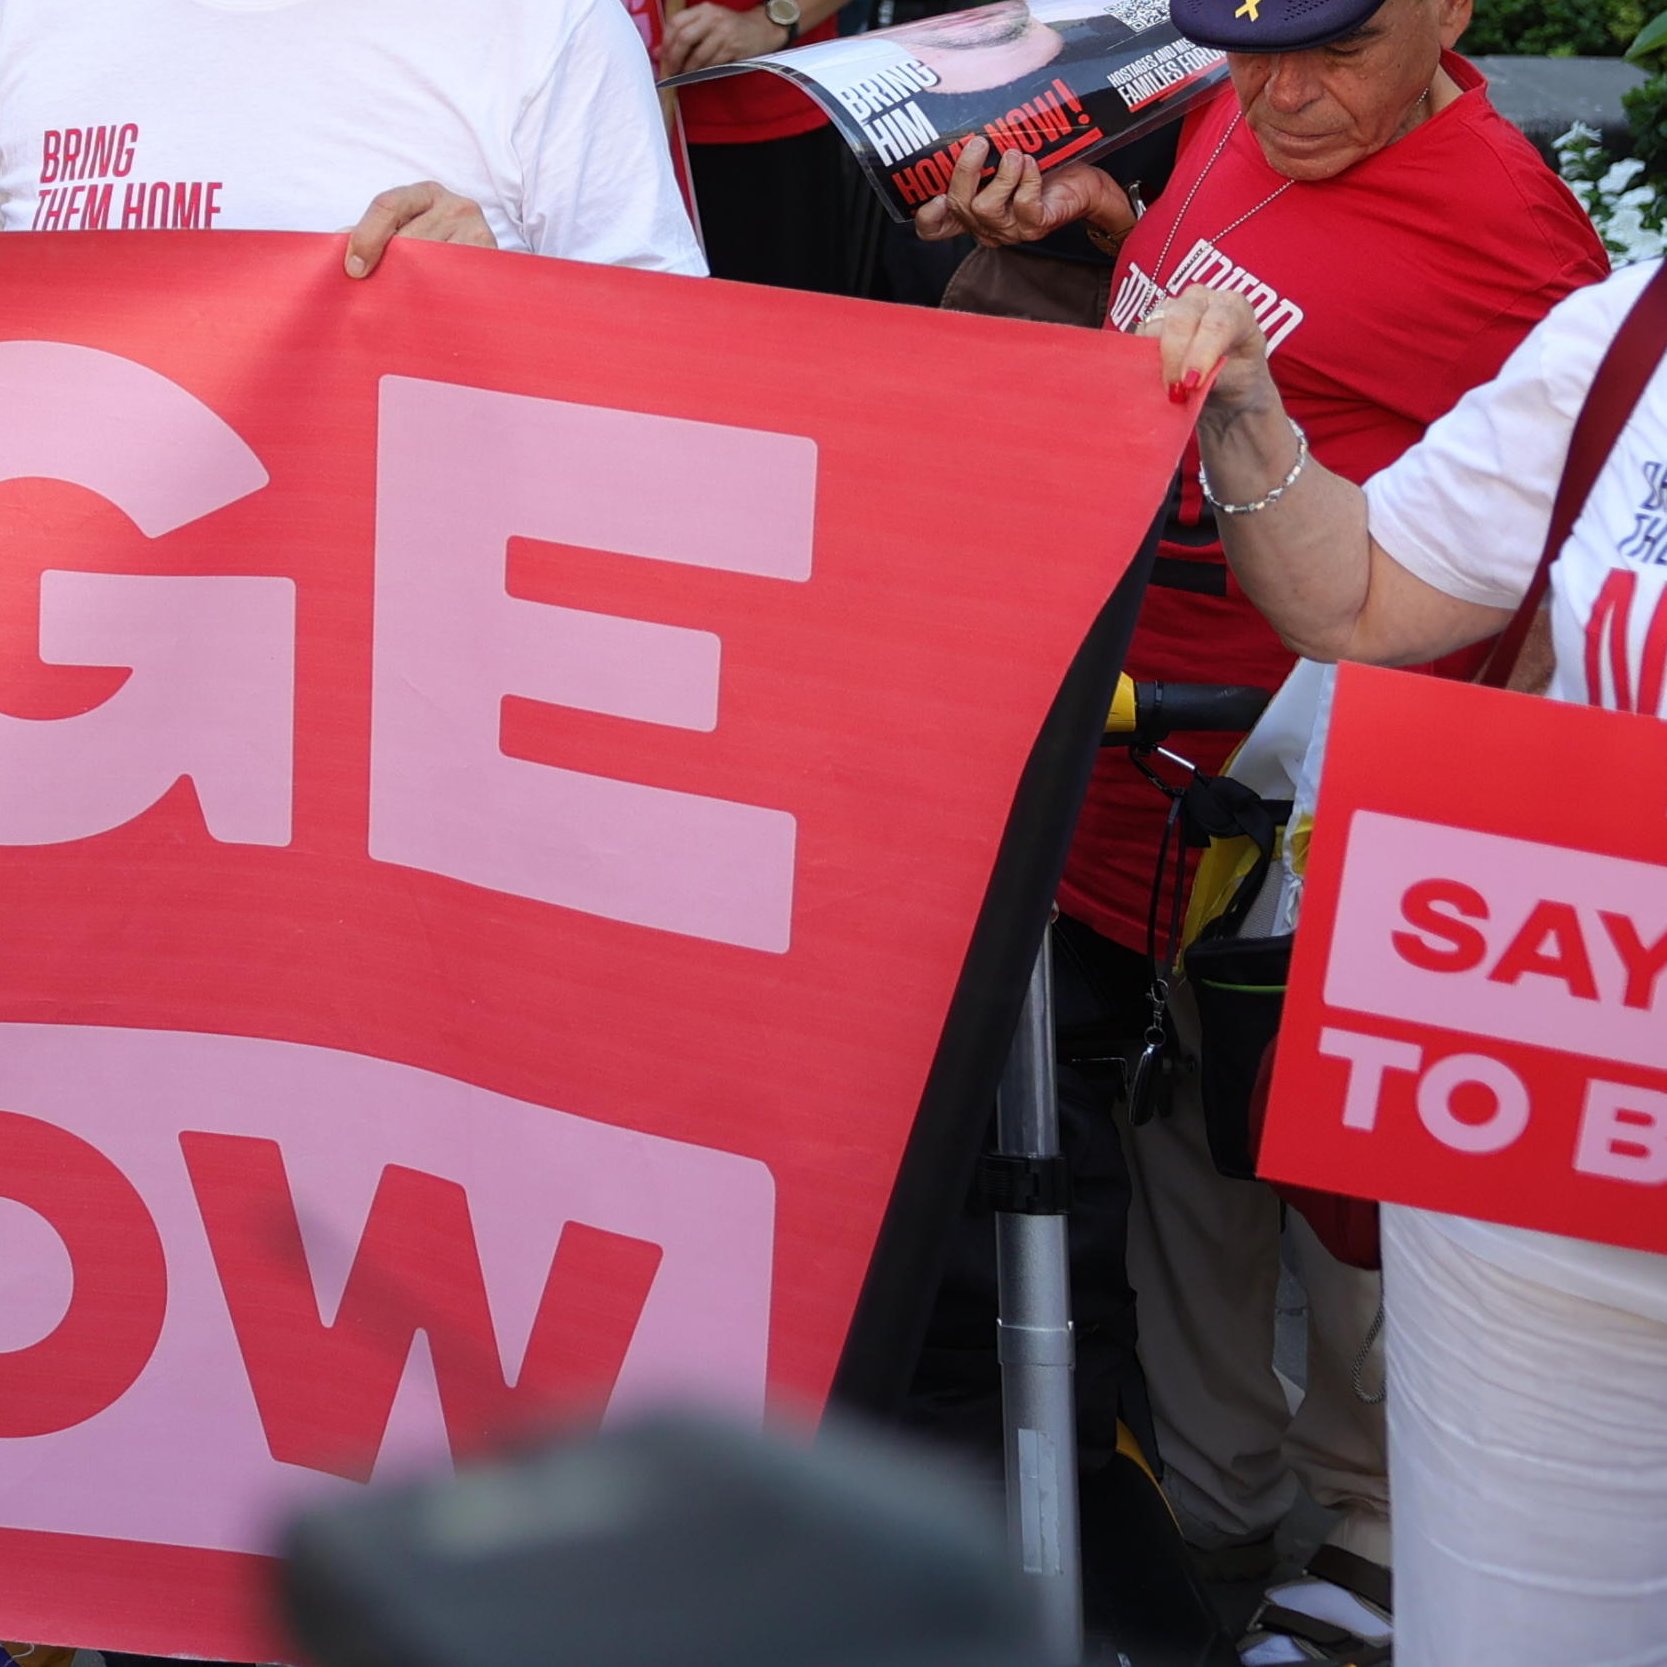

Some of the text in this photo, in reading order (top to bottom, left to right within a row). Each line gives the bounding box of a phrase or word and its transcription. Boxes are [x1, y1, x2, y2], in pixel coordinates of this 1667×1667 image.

[829, 58, 941, 122] BRING
[1106, 54, 1158, 88] HOSTAGES
[1153, 45, 1177, 64] AND
[1117, 61, 1185, 108] FAMILIES
[864, 100, 940, 167] HIM
[985, 77, 1093, 157] NOW!
[40, 123, 139, 184] BRING
[32, 181, 223, 231] THEM HOME
[1318, 1025, 1533, 1157] TO
